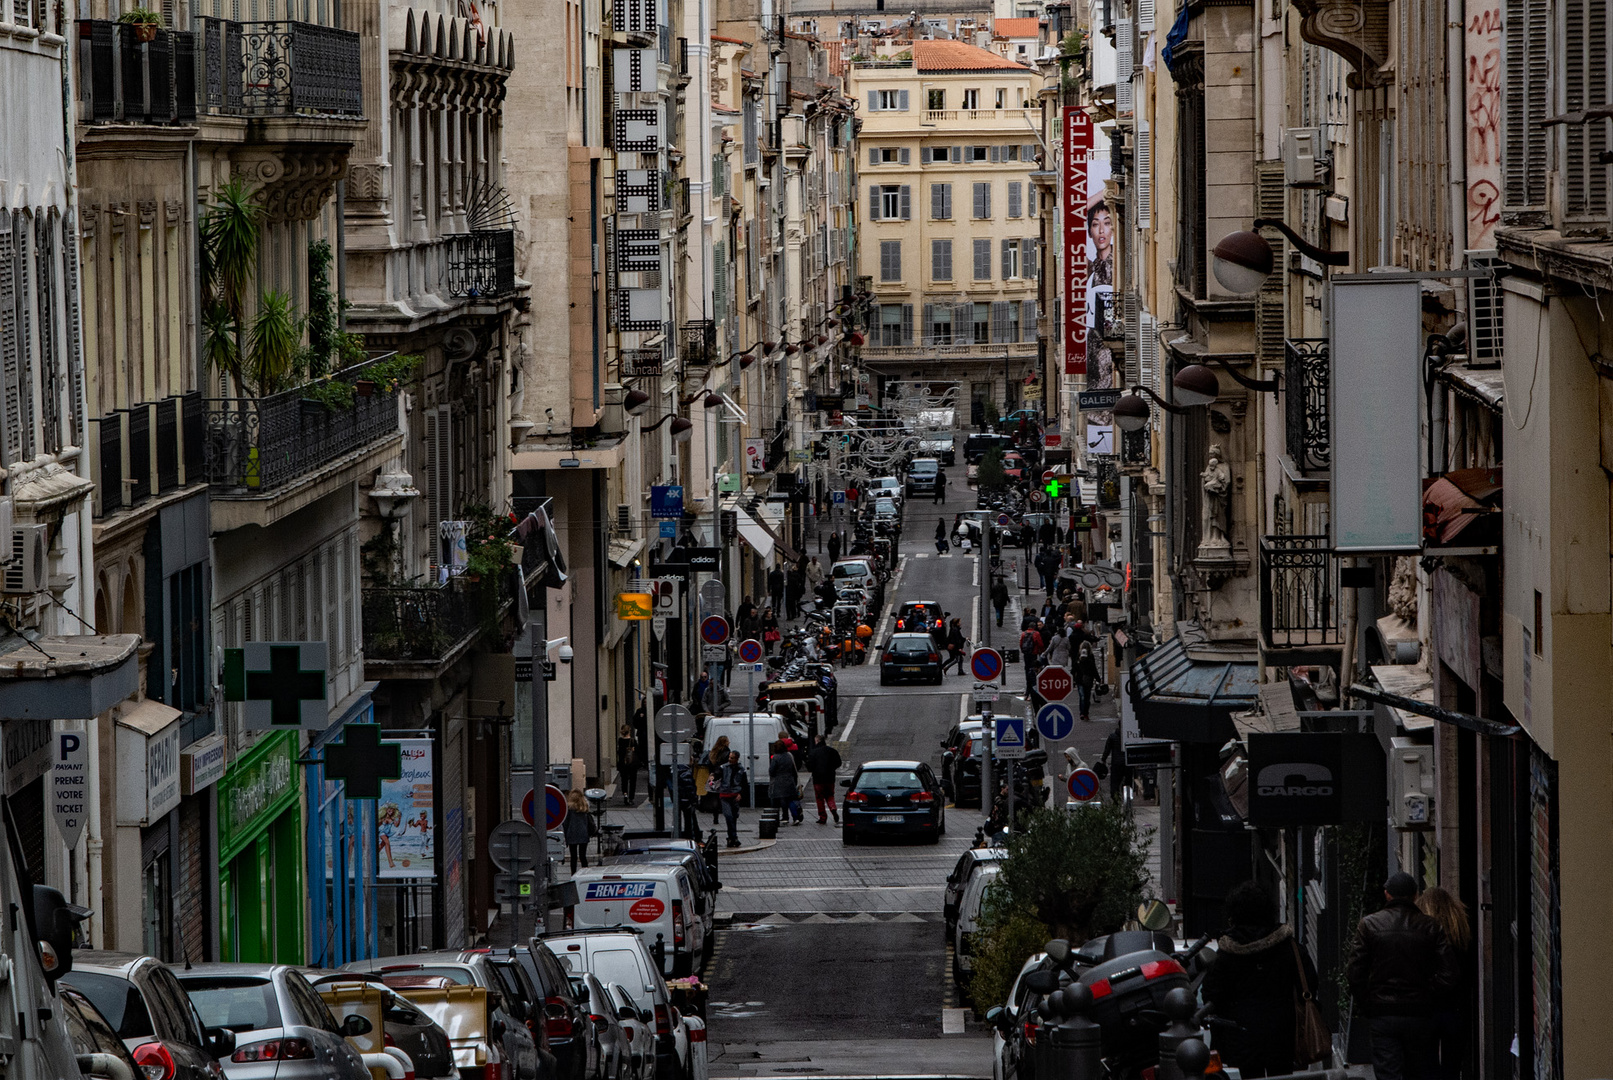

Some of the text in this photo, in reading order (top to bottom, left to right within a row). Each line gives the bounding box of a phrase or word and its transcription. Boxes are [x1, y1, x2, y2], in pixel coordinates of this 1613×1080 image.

[1070, 116, 1087, 233] LAFAYETTE
[1070, 243, 1087, 344] GALERIES
[658, 573, 685, 581] adidas
[1041, 679, 1069, 690] STOP
[61, 735, 80, 760] P
[54, 776, 84, 785] PRENEZ
[56, 791, 83, 799] VOTRE
[1257, 786, 1334, 796] CARGO
[56, 804, 83, 813] TICKET
[65, 819, 77, 827] ICI
[595, 884, 622, 897] RENT
[625, 884, 647, 896] CAR
